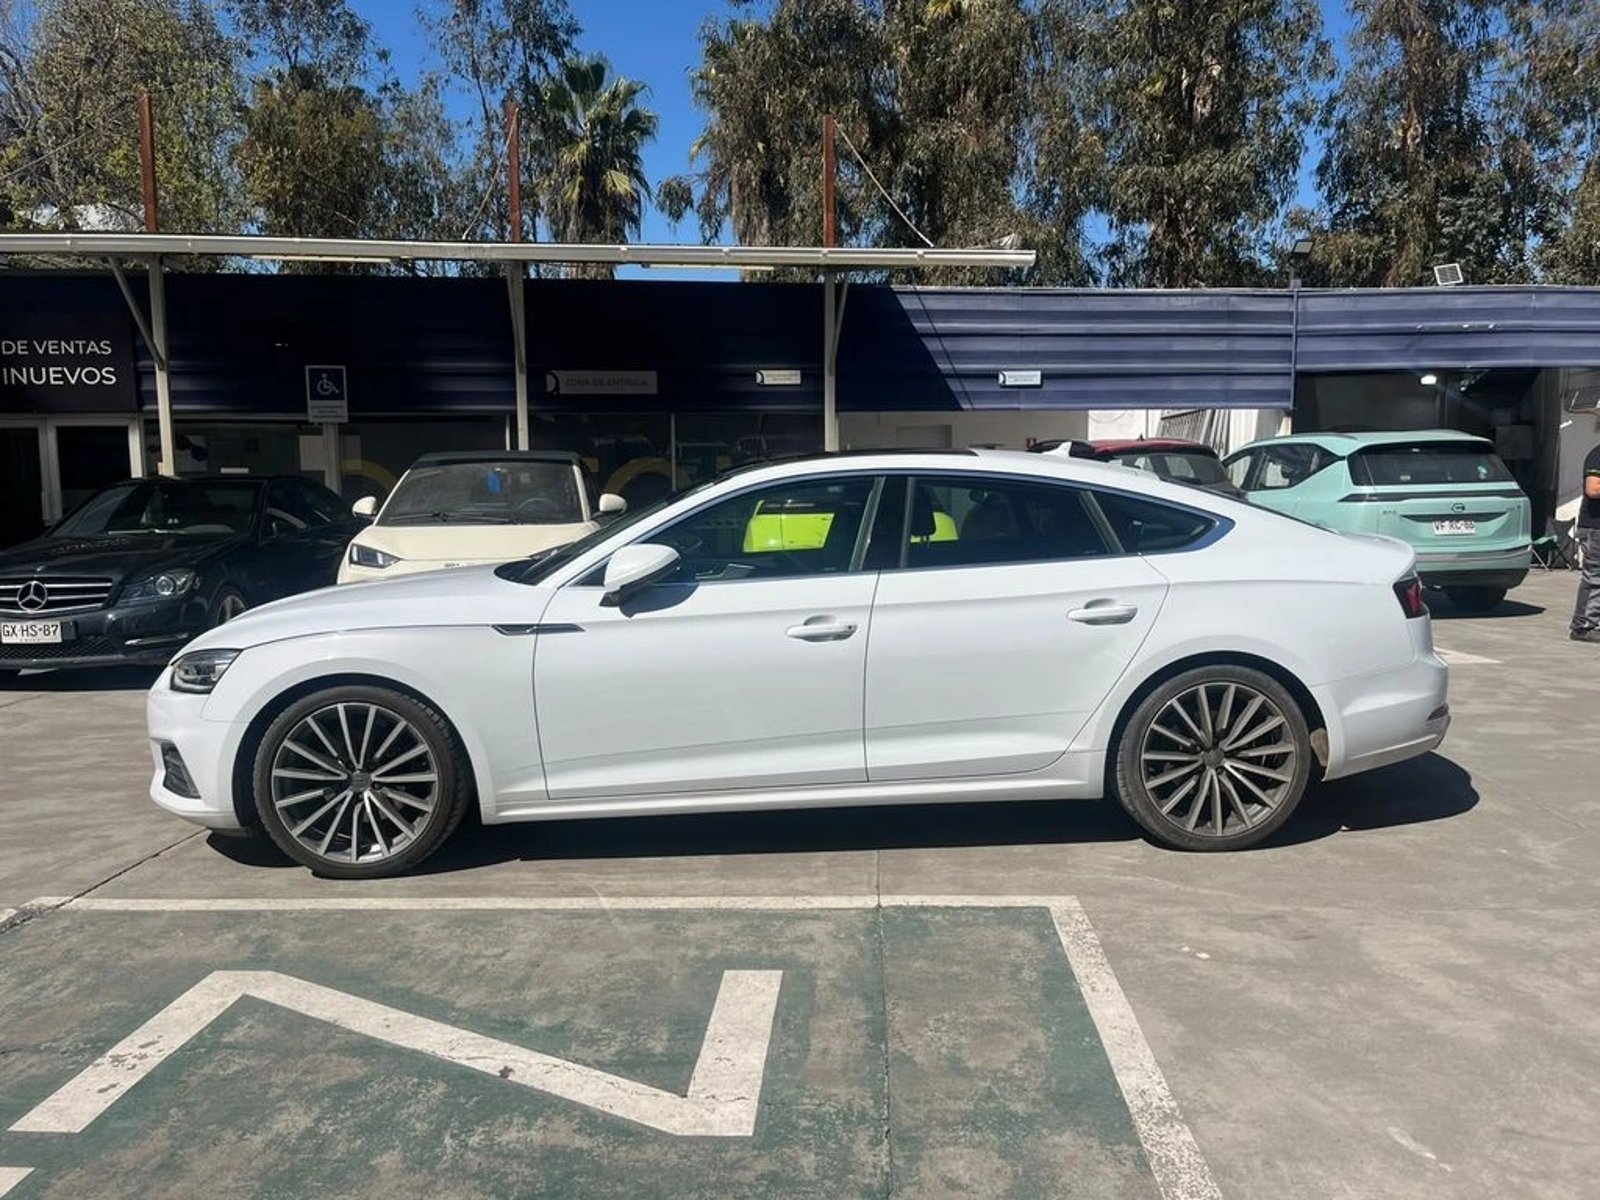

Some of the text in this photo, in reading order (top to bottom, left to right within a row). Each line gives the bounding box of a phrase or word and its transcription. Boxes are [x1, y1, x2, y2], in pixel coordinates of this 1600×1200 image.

[1, 340, 112, 355] DE VENTAS
[2, 366, 117, 385] INUEVOS
